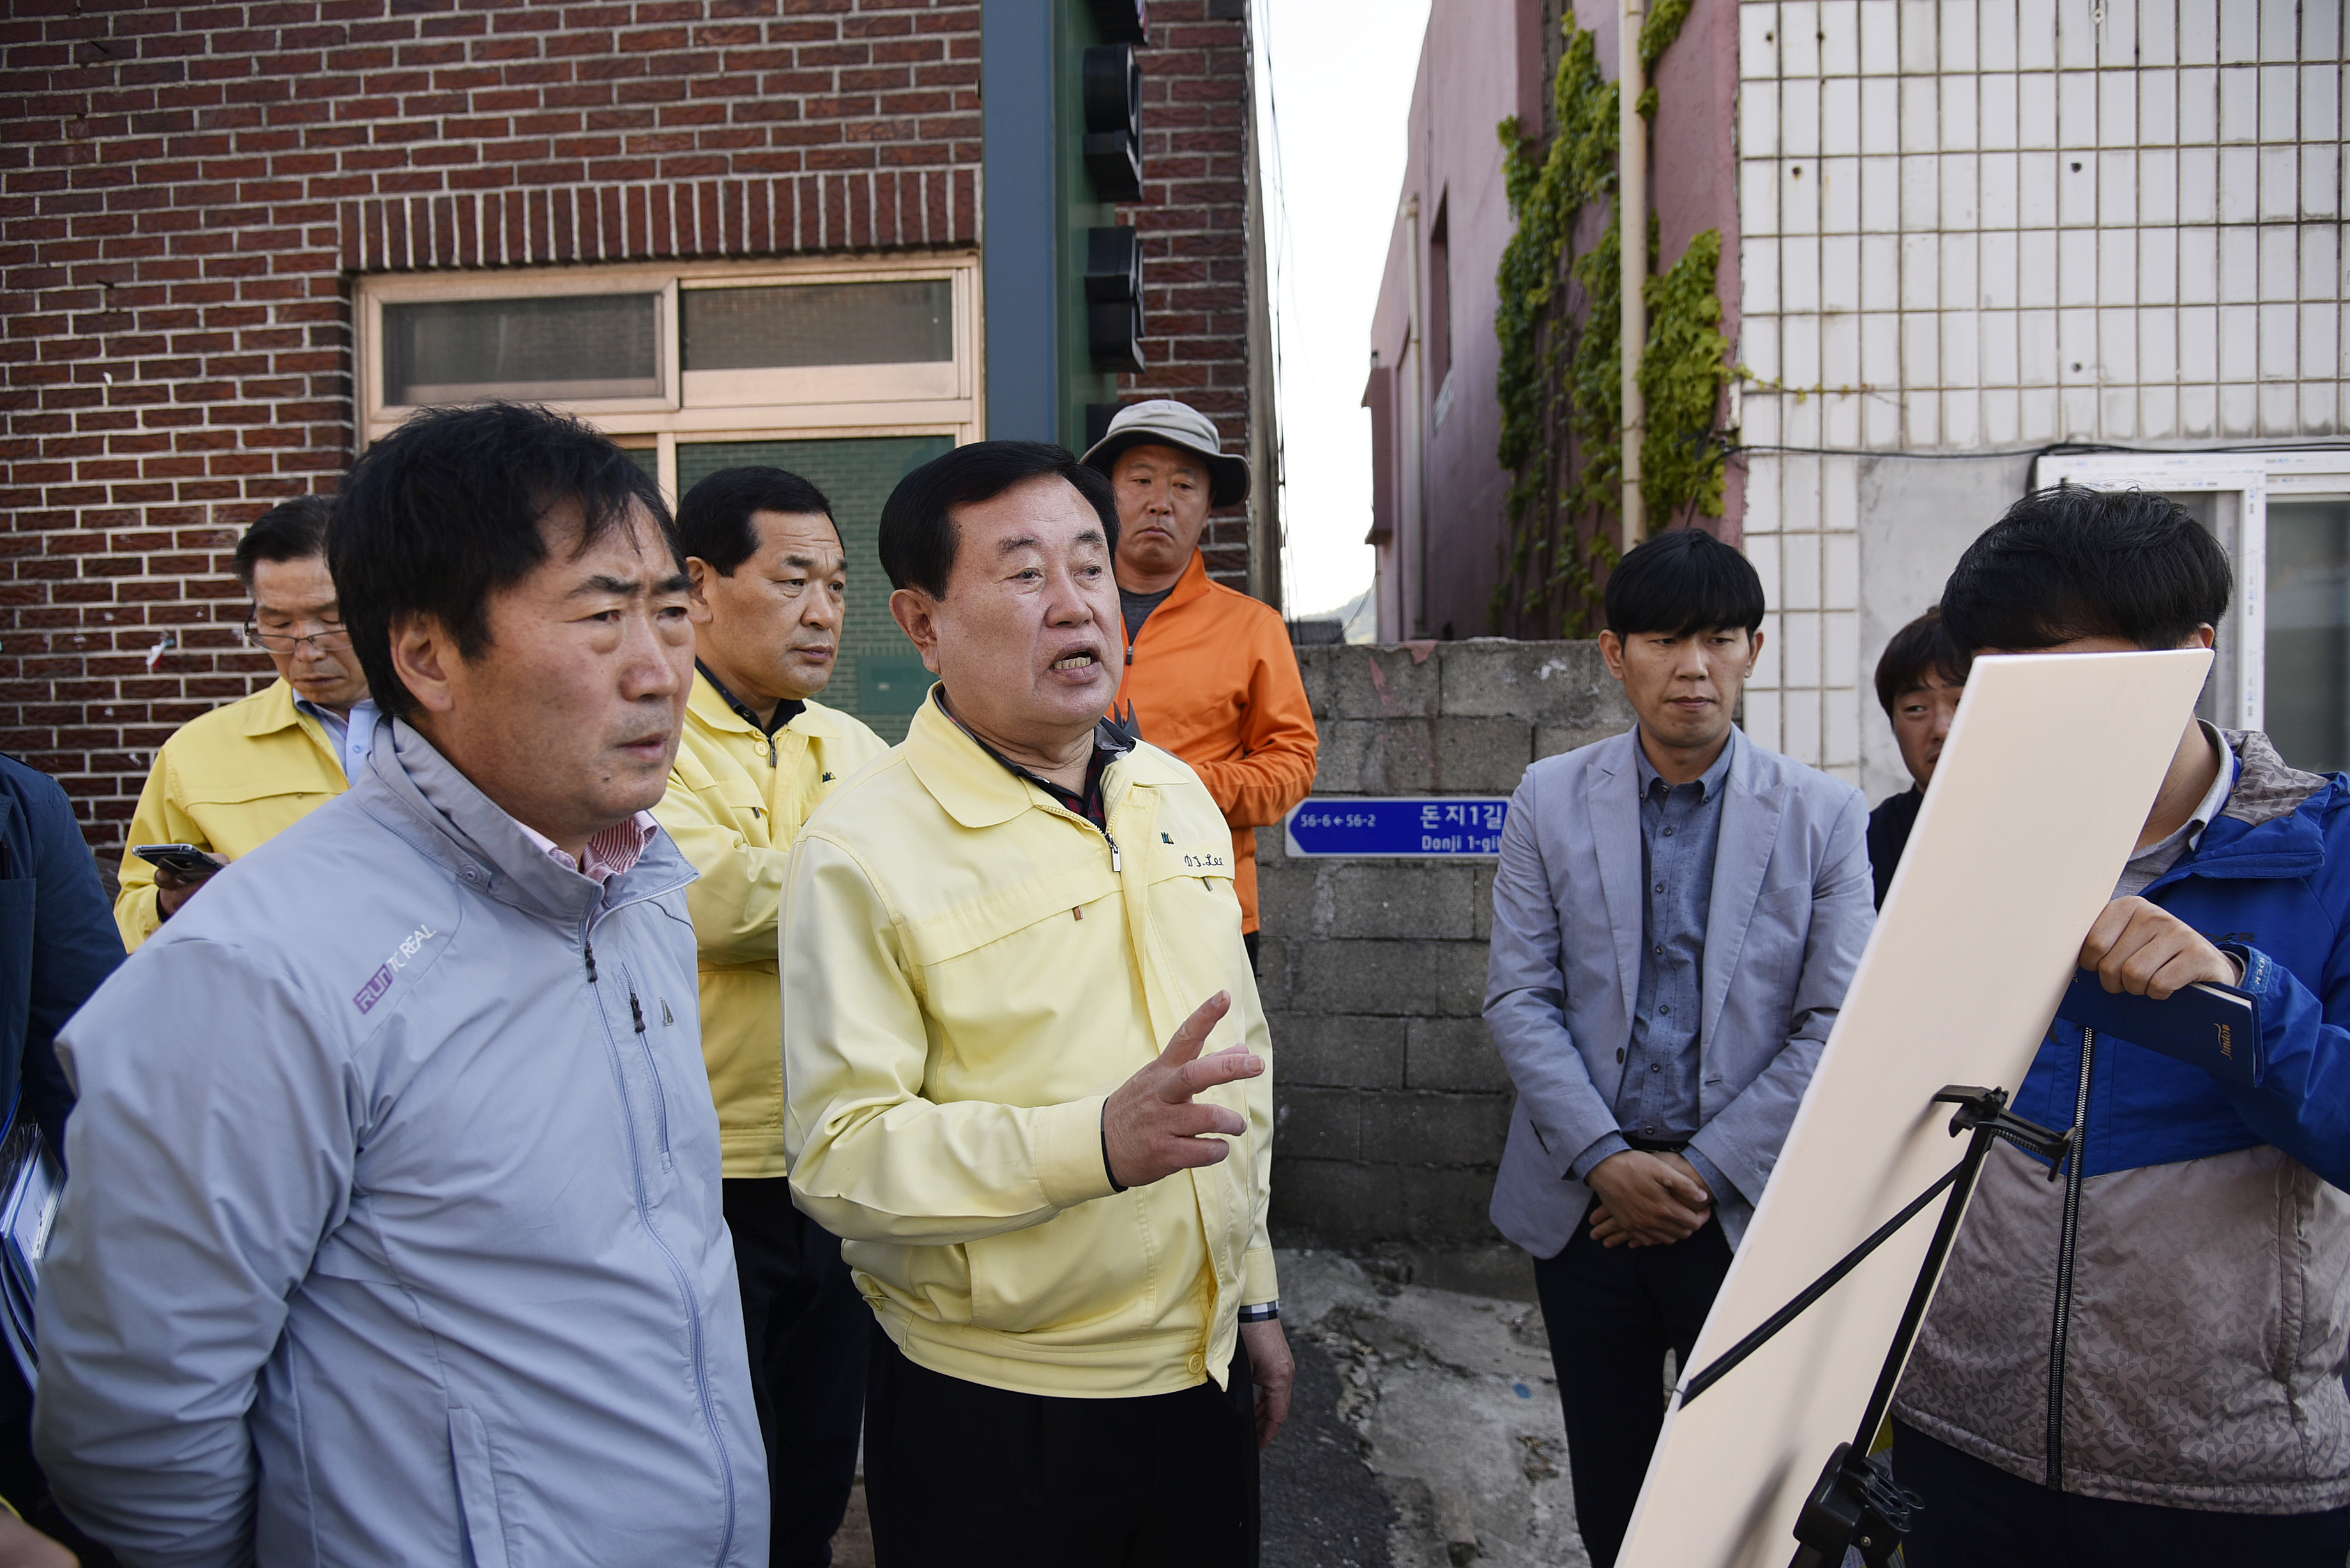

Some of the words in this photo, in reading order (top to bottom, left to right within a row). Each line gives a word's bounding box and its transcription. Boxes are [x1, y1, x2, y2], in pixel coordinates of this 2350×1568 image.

[1300, 814, 1331, 827] 56-6
[1346, 814, 1376, 827] 56-2
[1420, 805, 1503, 829] 돈지1길
[1421, 835, 1462, 852] Donji
[399, 924, 437, 959] REAL
